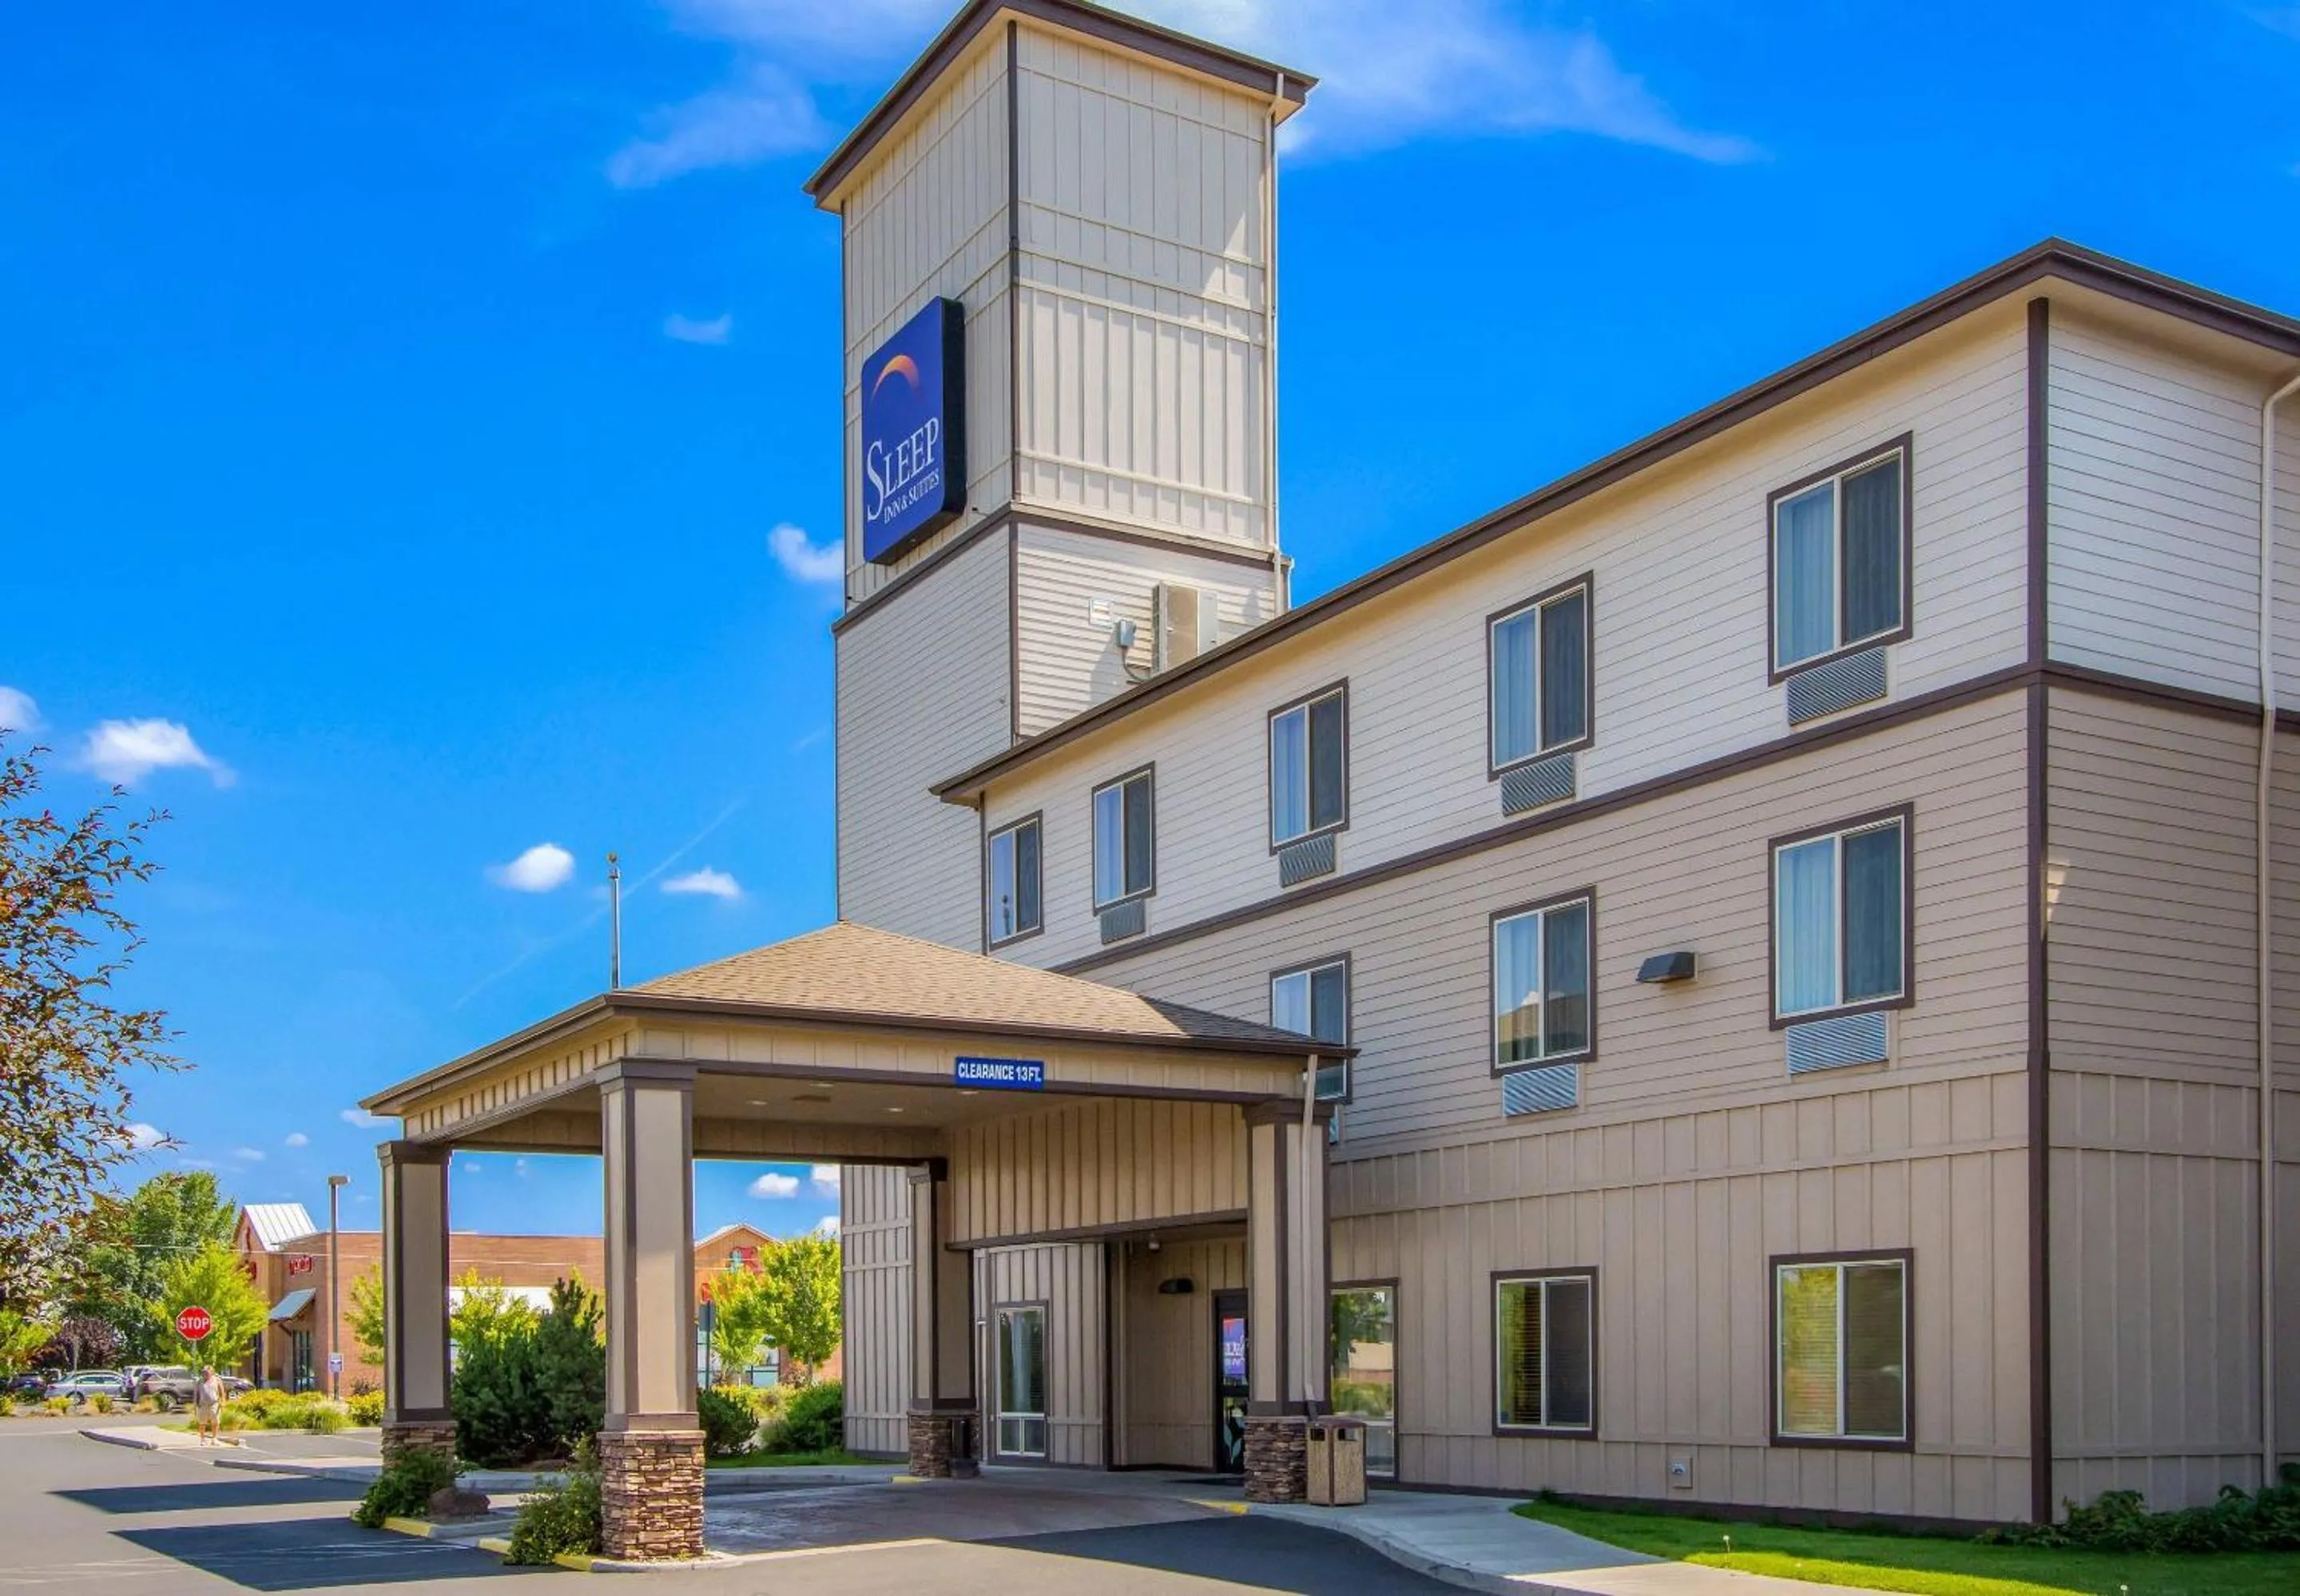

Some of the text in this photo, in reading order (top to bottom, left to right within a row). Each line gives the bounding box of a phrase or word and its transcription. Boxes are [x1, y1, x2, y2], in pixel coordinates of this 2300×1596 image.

[867, 417, 939, 522] SLEEP
[884, 497, 901, 524] INN
[909, 471, 939, 506] SUITES
[958, 1062, 1014, 1080] CLEARANCE
[179, 1317, 209, 1330] STOP
